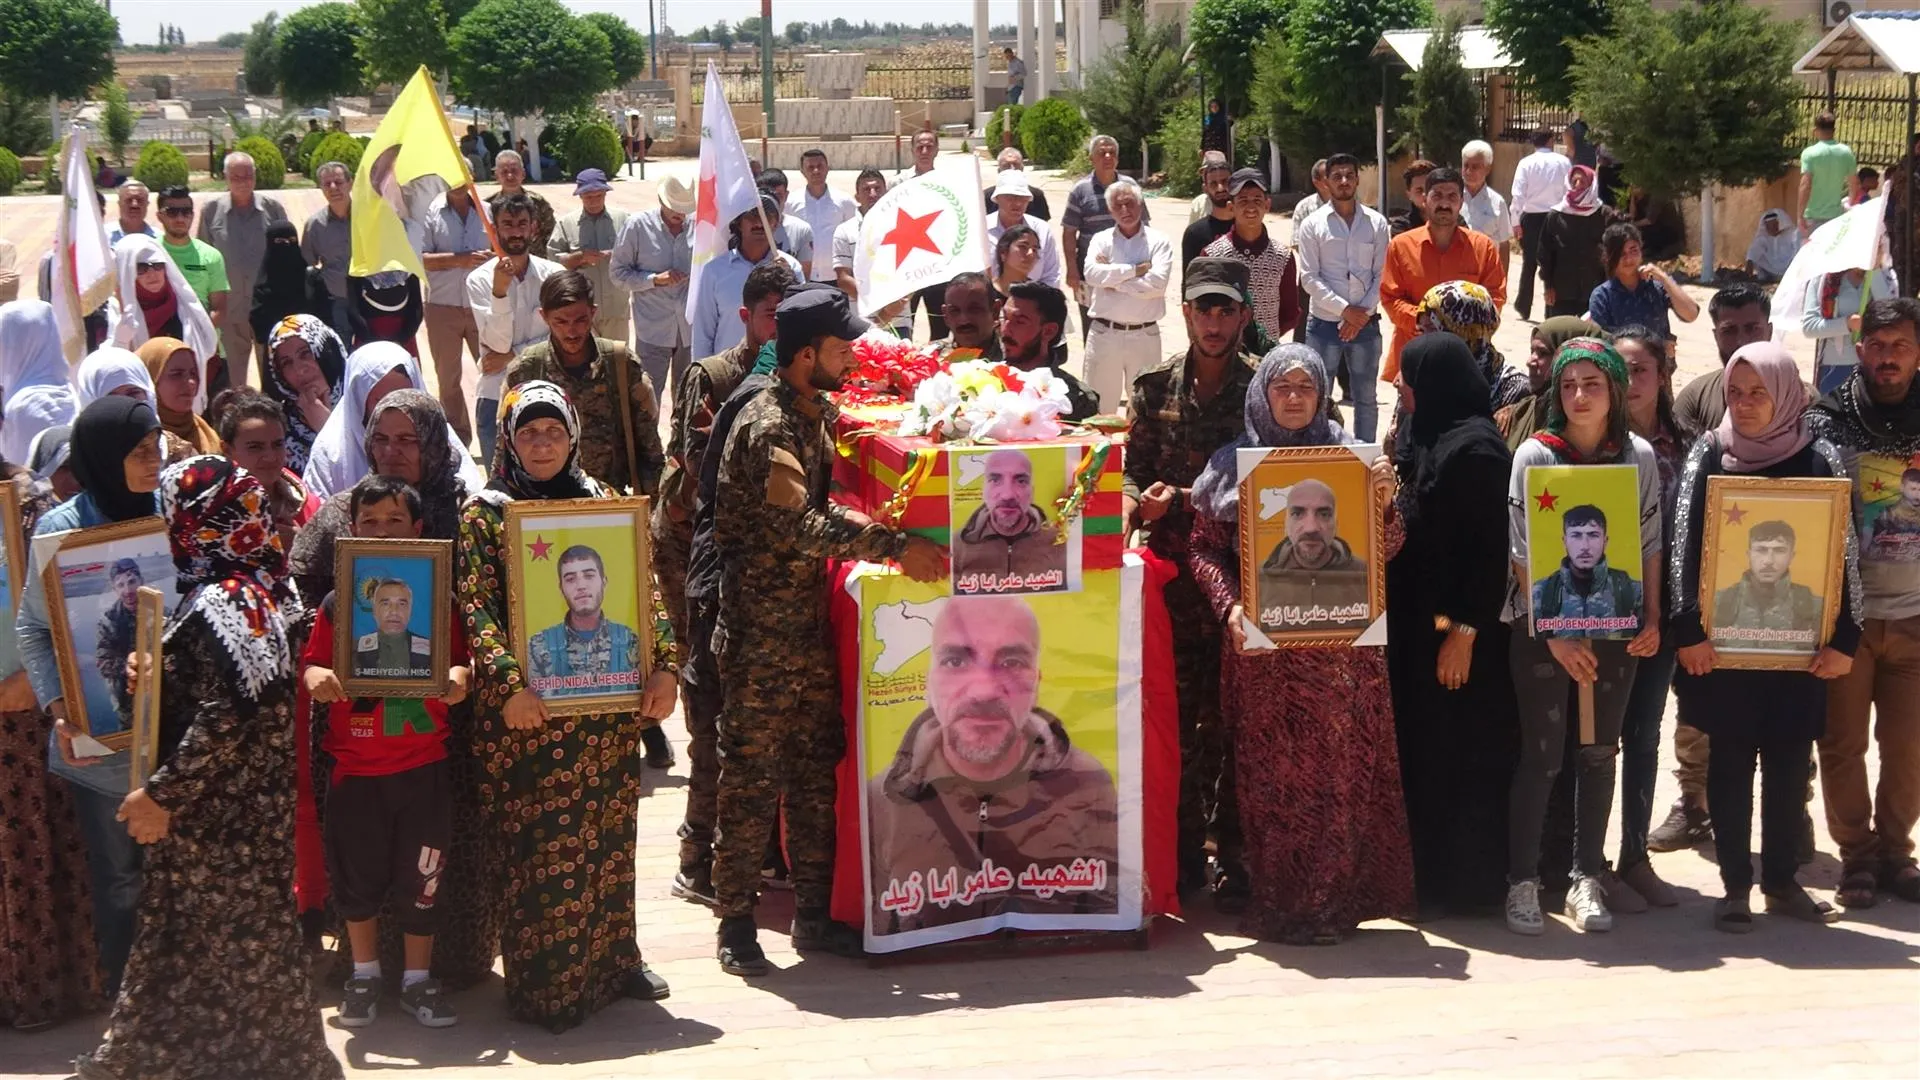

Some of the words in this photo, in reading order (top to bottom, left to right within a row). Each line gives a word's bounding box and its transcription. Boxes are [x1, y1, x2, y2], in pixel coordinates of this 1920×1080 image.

[957, 573, 979, 594] زيد
[998, 572, 1023, 592] عامر
[1024, 570, 1063, 590] الشهيد
[1260, 606, 1282, 626] زيد
[1300, 604, 1328, 625] عامر
[1329, 603, 1368, 624] الشهيد
[927, 867, 957, 908] ابا
[957, 858, 1014, 905] عامر
[1019, 858, 1106, 897] الشهيد
[881, 871, 923, 915] زيد
